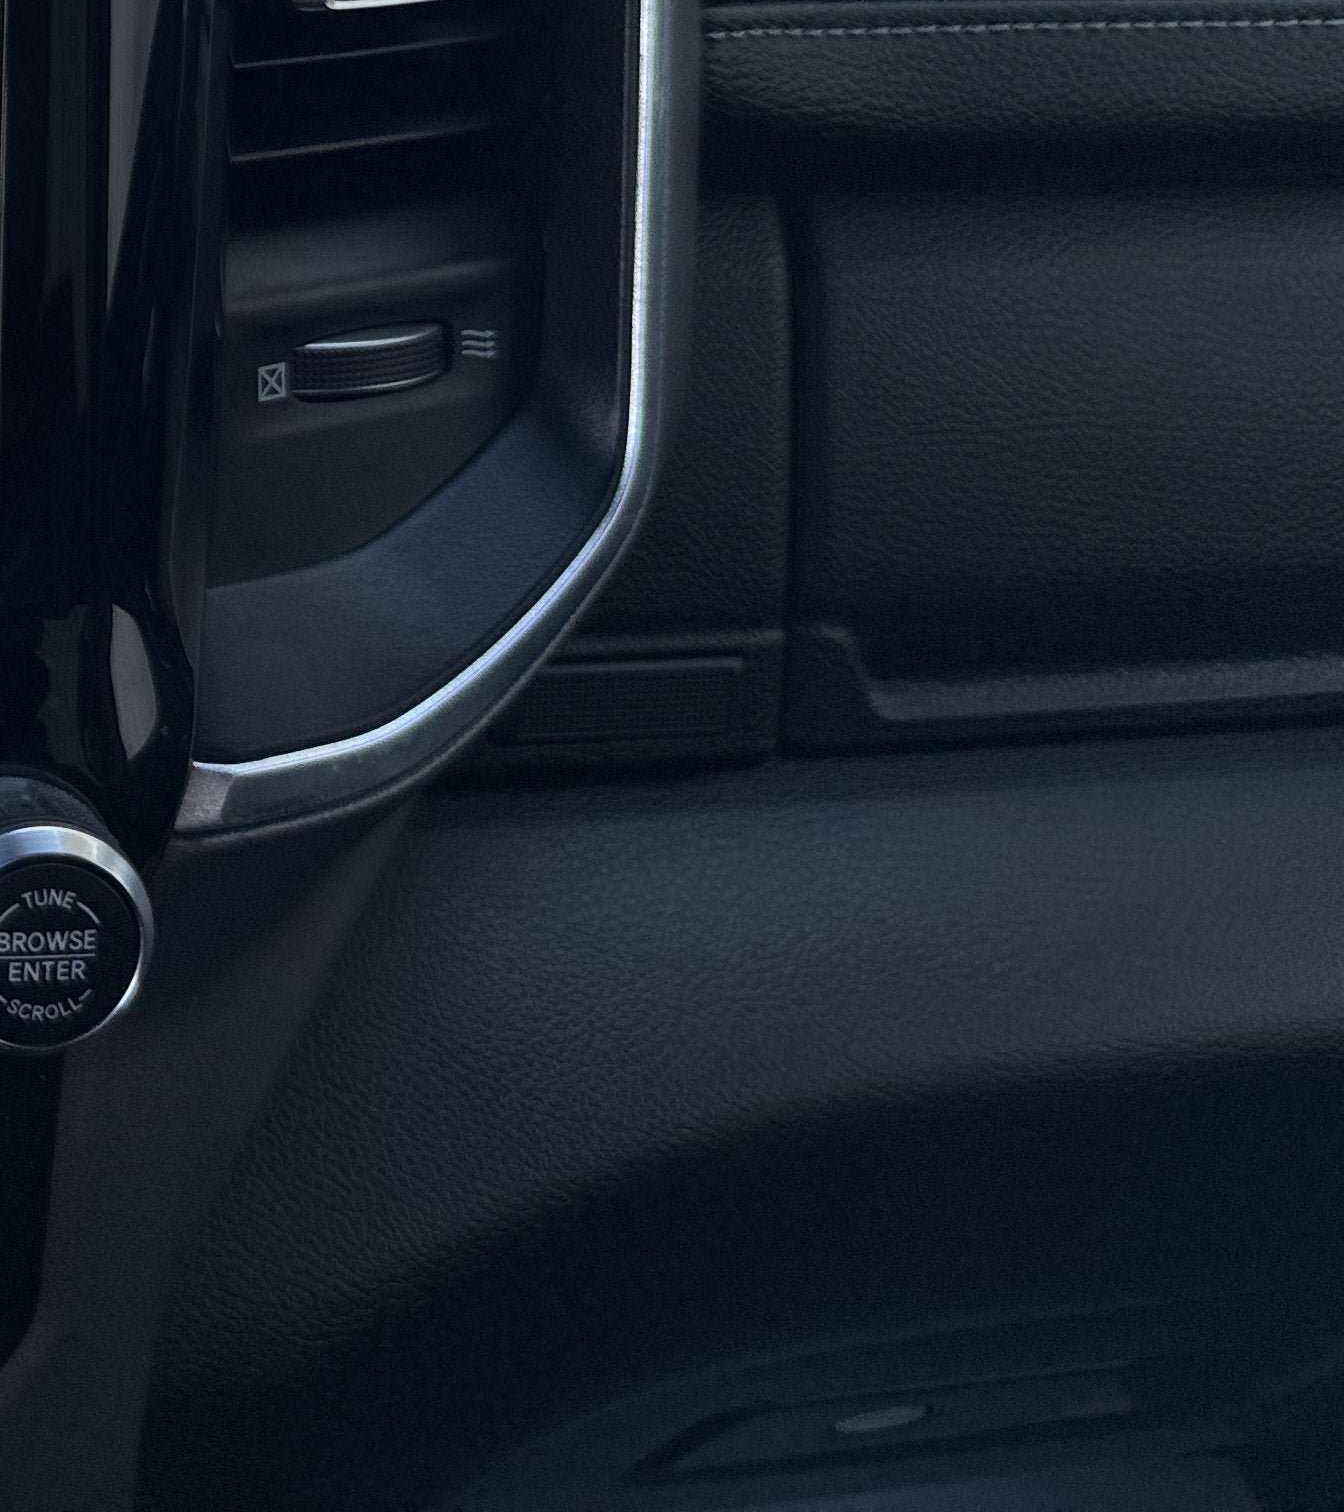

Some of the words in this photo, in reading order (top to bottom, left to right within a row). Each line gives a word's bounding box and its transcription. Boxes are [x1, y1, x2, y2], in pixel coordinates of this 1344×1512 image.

[21, 888, 78, 909] TUNE
[9, 961, 85, 982] ENTER
[6, 996, 82, 1021] SCROLL
